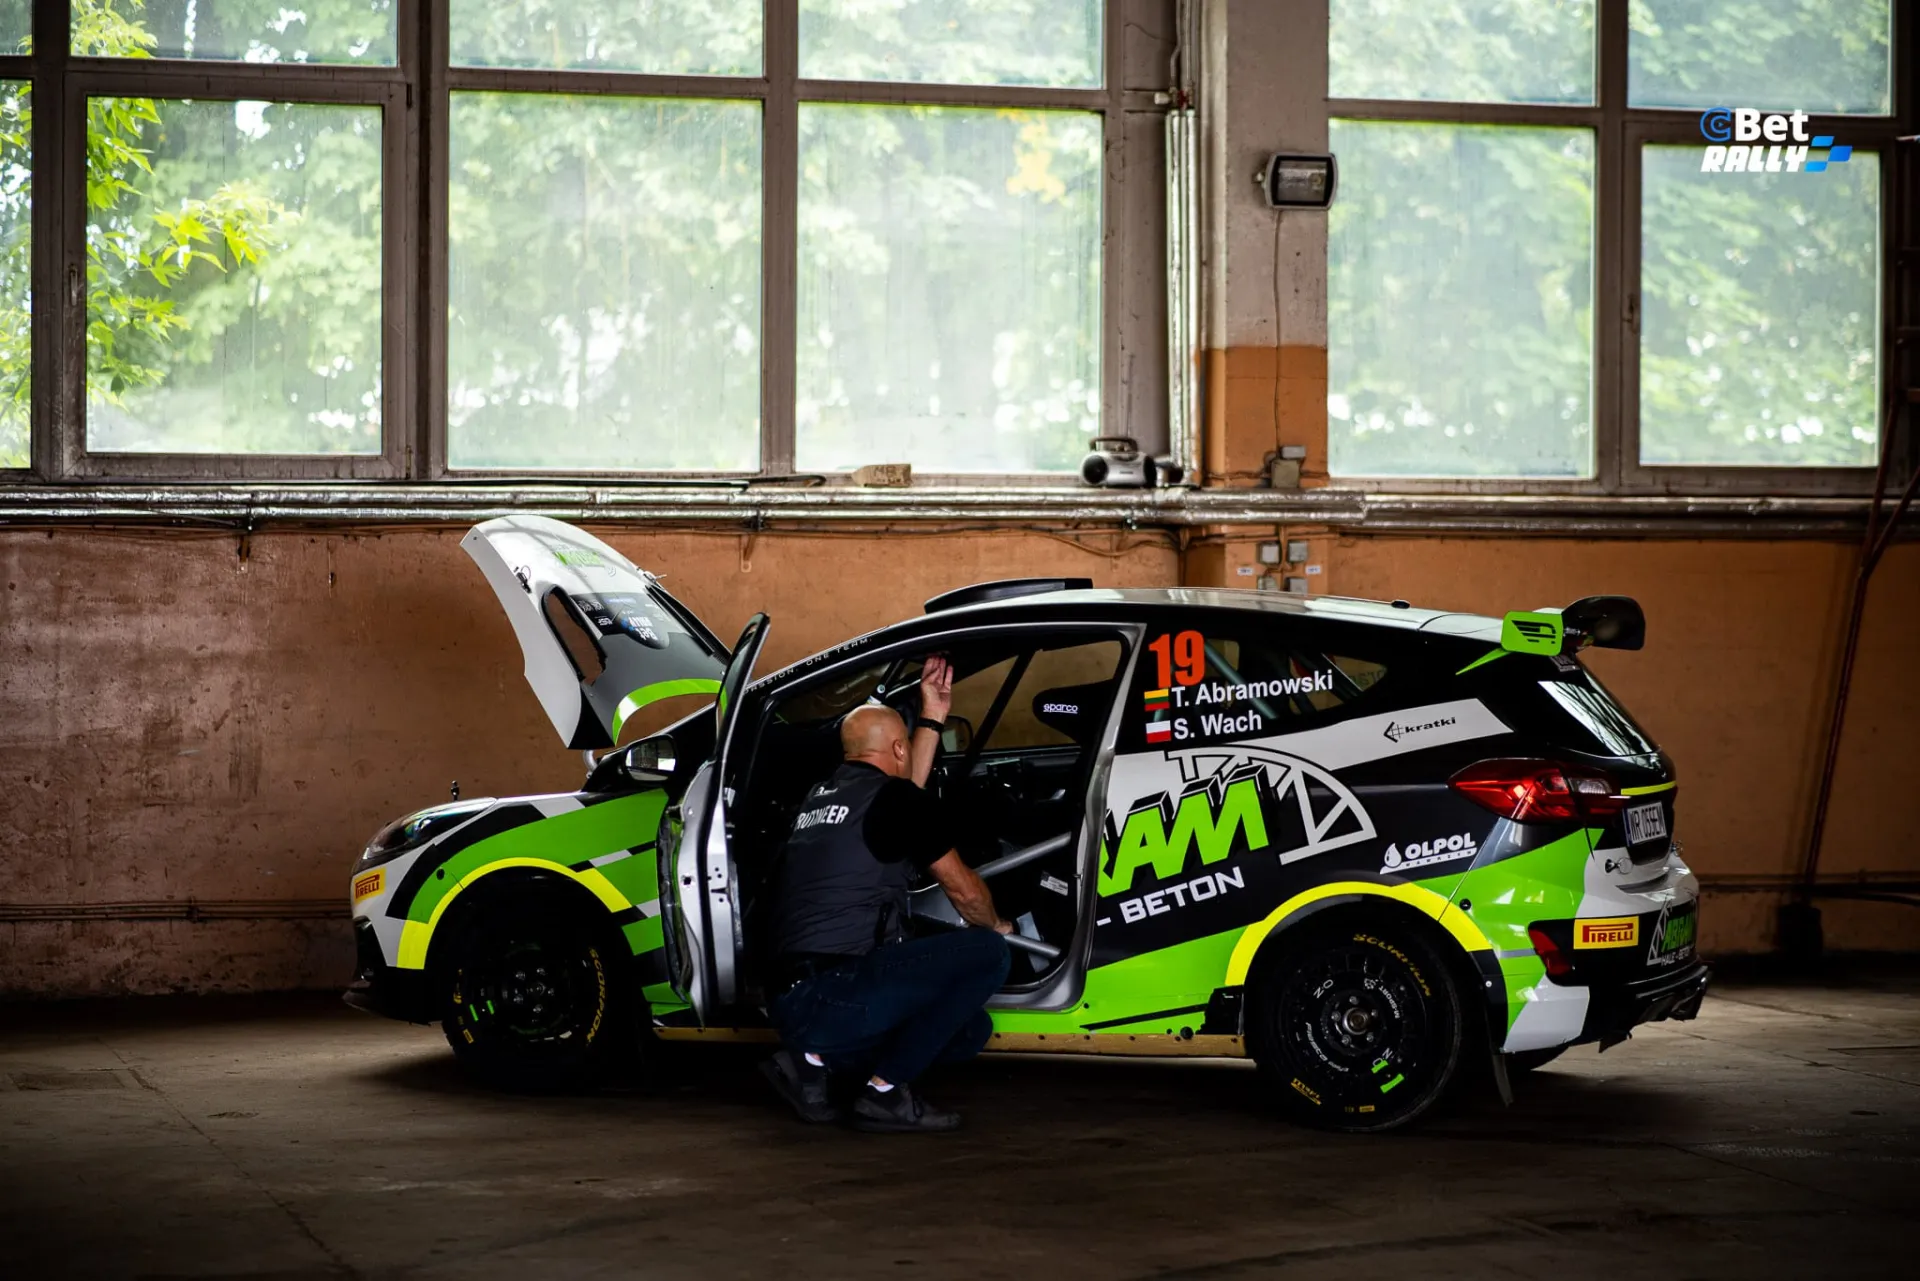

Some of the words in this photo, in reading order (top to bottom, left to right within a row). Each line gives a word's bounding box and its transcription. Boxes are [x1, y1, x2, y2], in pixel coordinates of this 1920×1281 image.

[805, 652, 830, 667] ONE
[1148, 629, 1205, 688] 19
[1172, 686, 1190, 708] T.
[1195, 668, 1333, 706] Abramowski
[1042, 702, 1079, 715] sparco
[1174, 717, 1195, 740] S.
[1201, 709, 1262, 736] Wach
[1404, 716, 1457, 734] kratki
[1404, 831, 1477, 860] OLPOL
[355, 873, 380, 900] PIRELLI
[1119, 866, 1246, 924] BETON
[1582, 922, 1634, 943] PIRELLI
